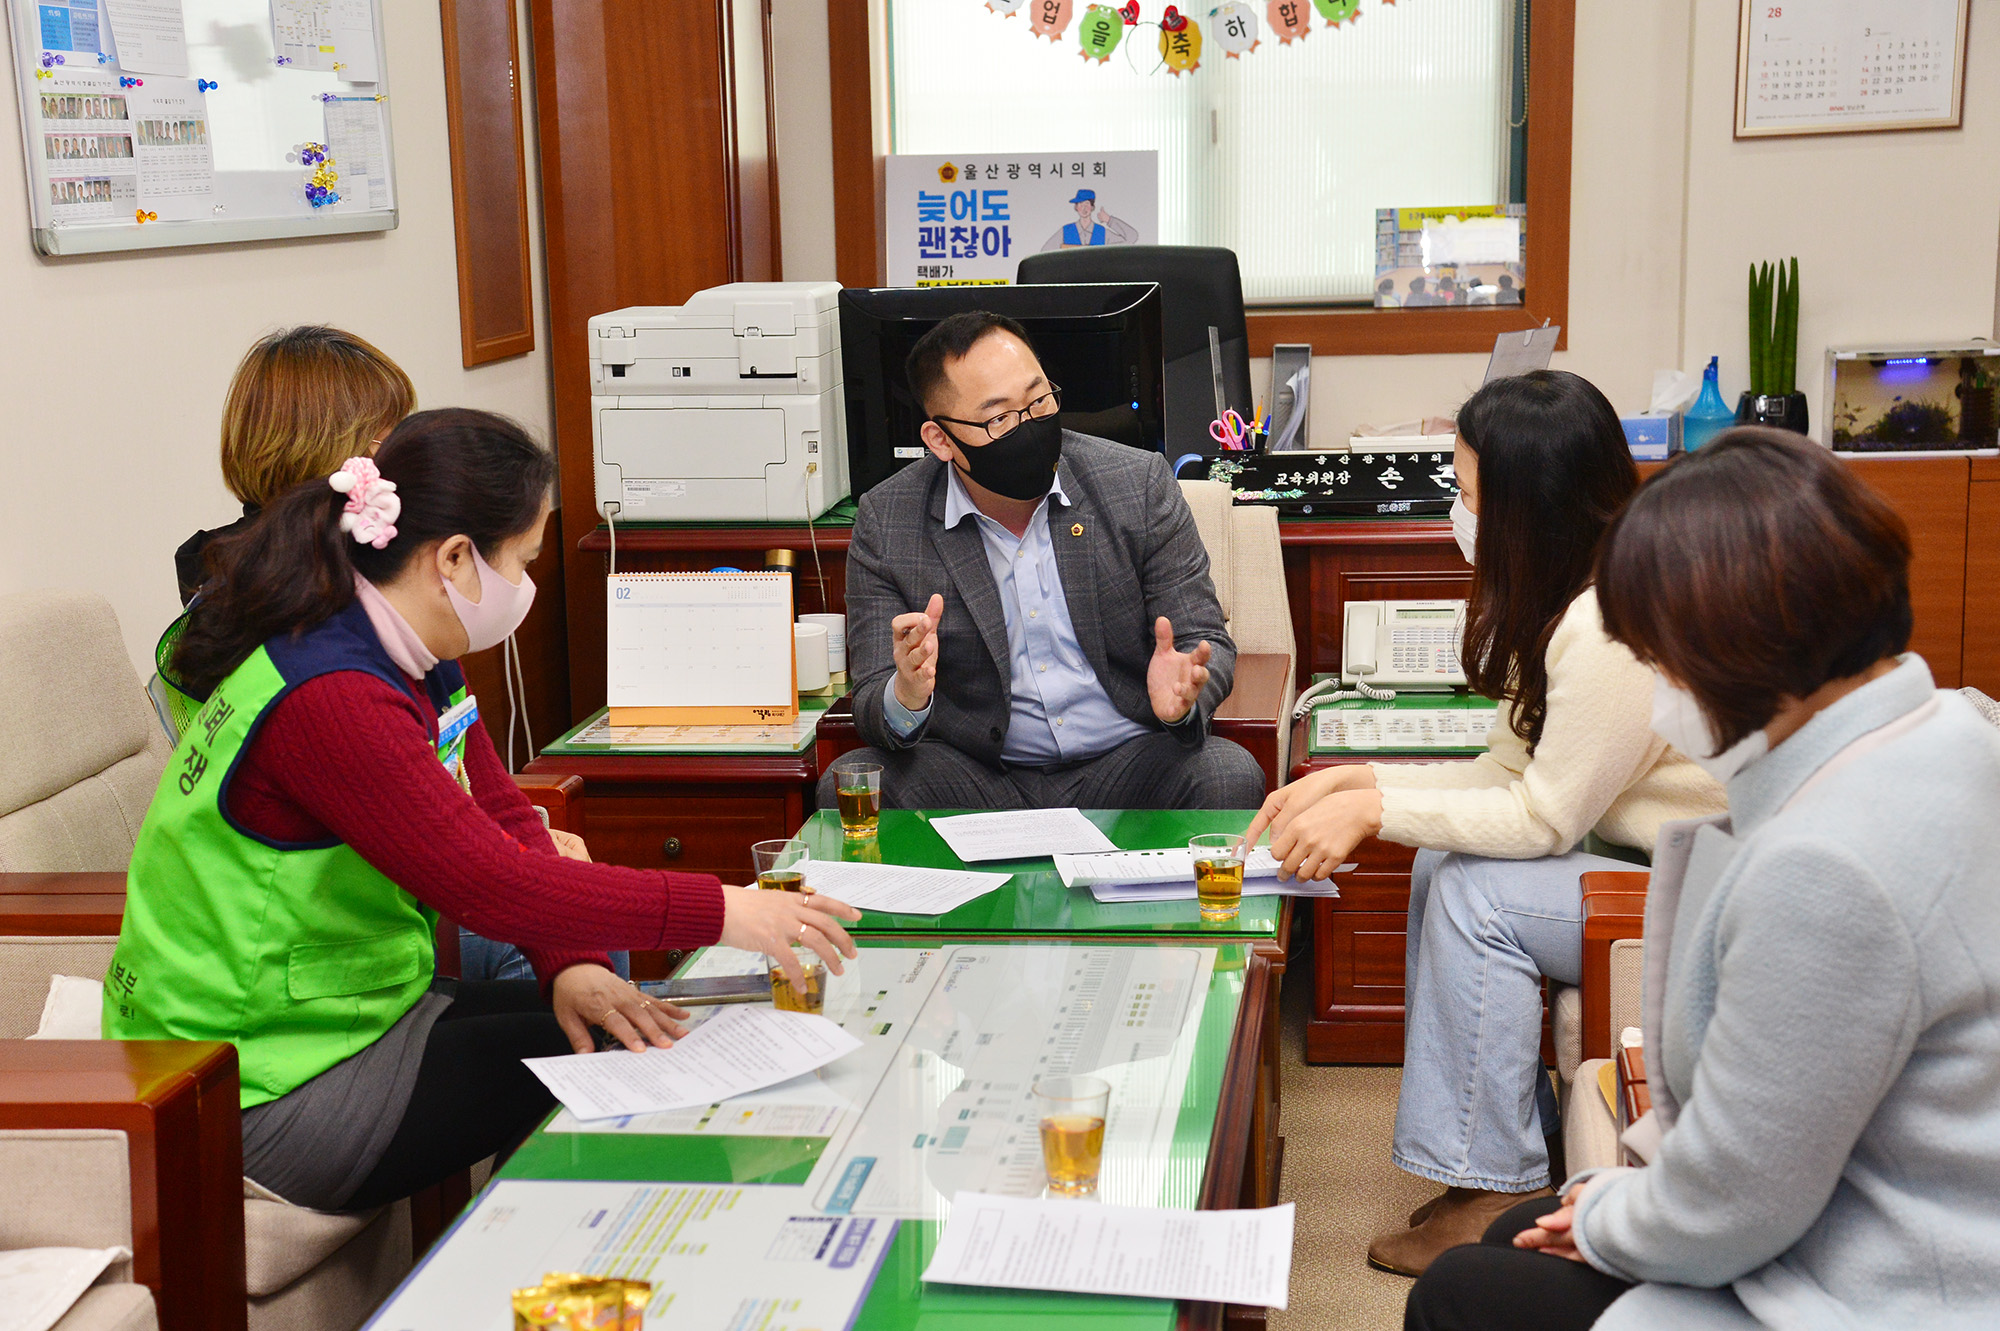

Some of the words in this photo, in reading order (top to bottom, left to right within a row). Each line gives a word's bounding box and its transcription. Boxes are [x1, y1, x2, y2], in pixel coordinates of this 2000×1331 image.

[1767, 7, 1782, 18] 28
[1864, 27, 1871, 37] 3
[963, 161, 1106, 181] 울산광역시의회
[917, 189, 1010, 223] 늦어도
[918, 225, 1012, 259] 괜찮아
[917, 265, 954, 278] 택배가
[1274, 471, 1351, 486] 교육위원장
[616, 587, 631, 600] 02
